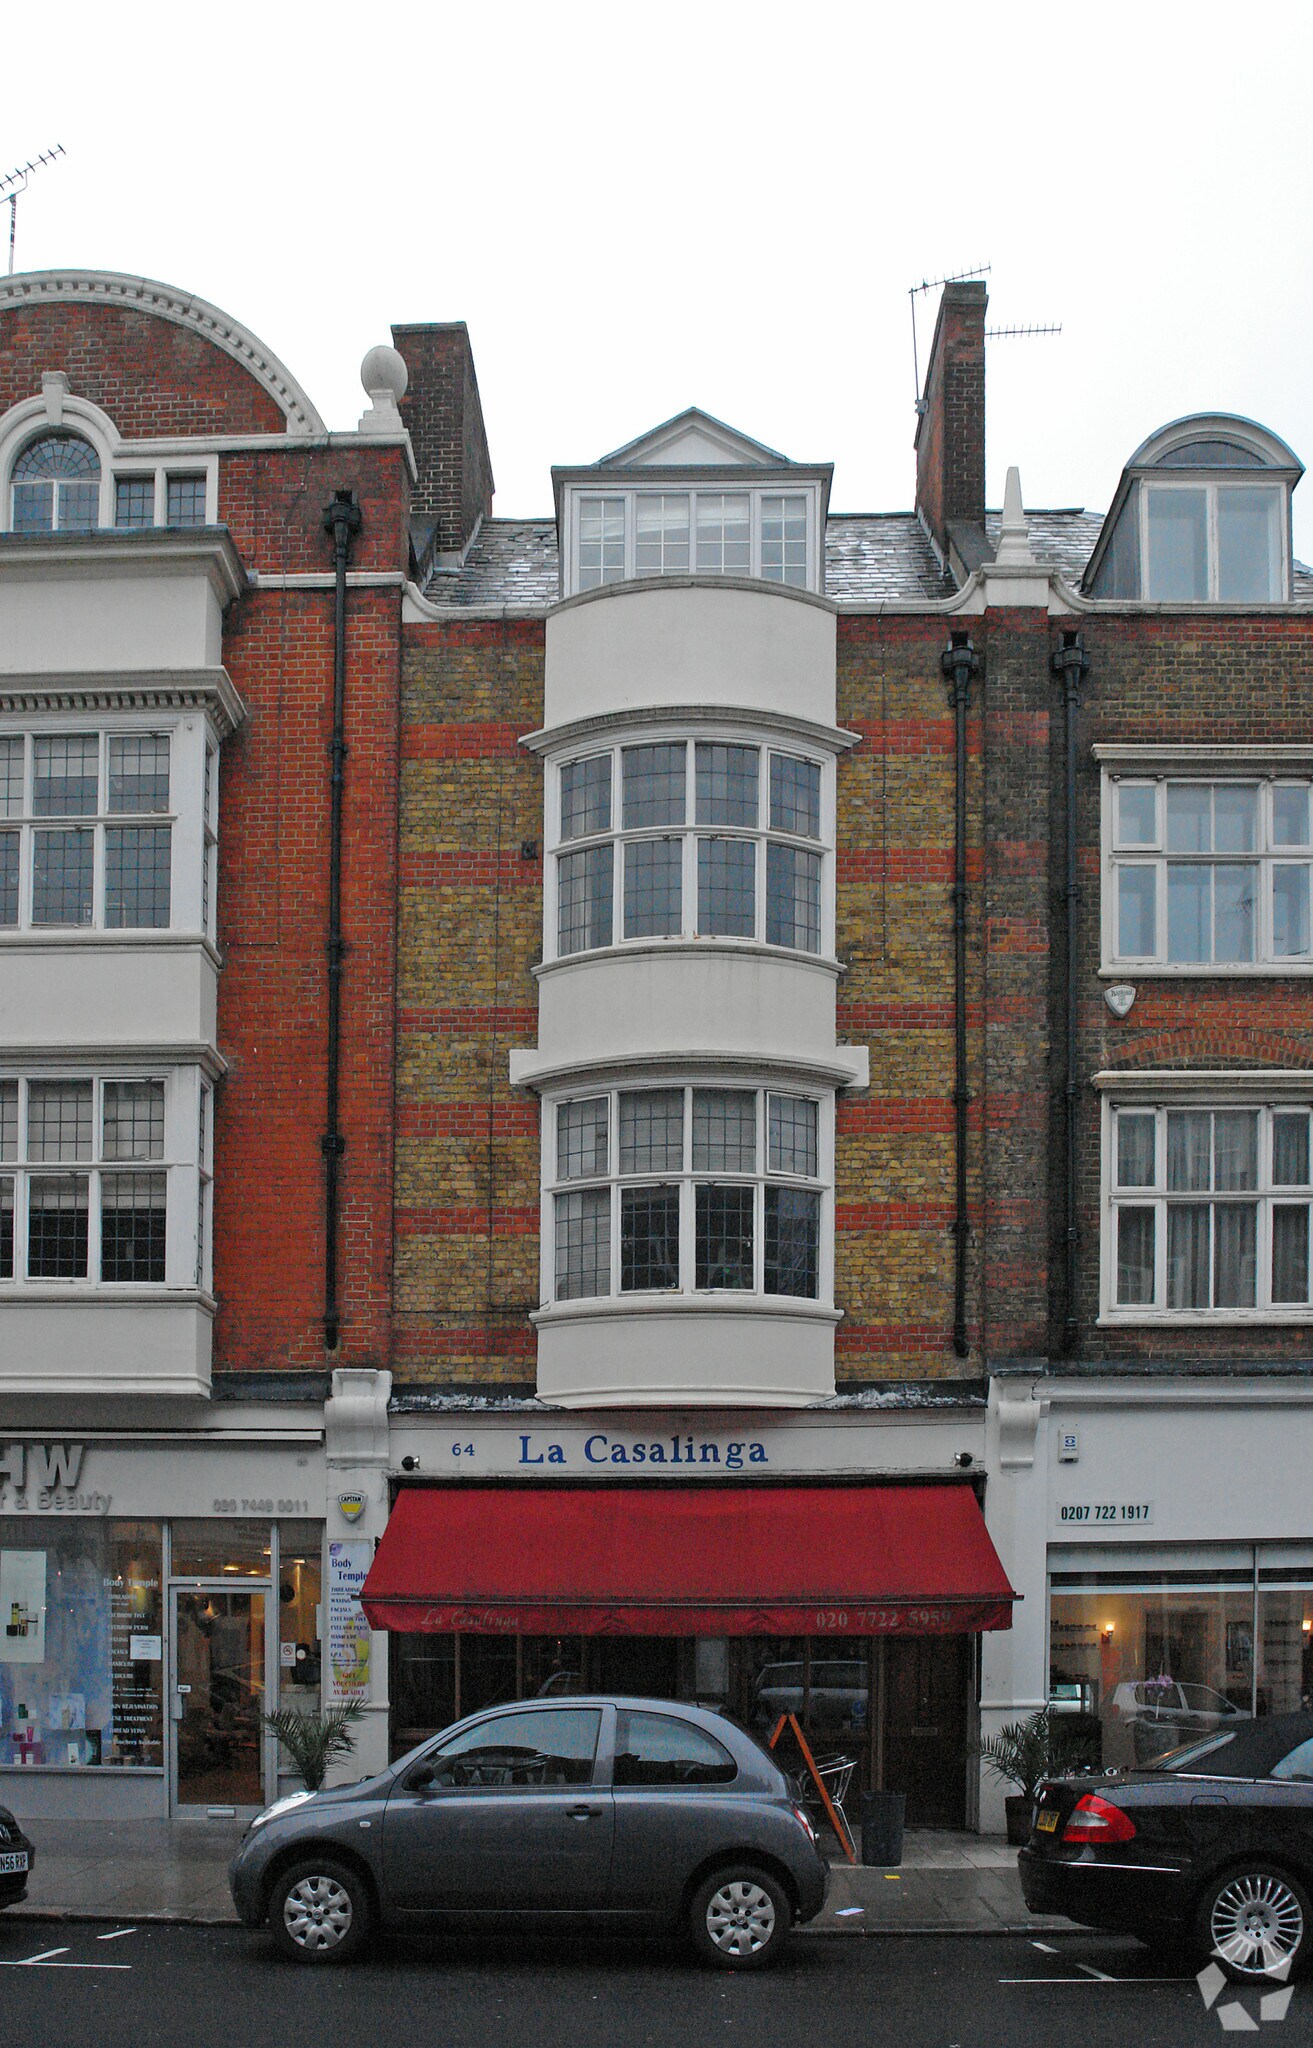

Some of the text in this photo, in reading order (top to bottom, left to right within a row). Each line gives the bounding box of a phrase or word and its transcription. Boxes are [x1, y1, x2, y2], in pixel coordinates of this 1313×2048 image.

[452, 1443, 475, 1456] 64
[519, 1435, 769, 1469] La Casalinga
[38, 1488, 113, 1515] Beauty
[213, 1498, 237, 1512] 020
[340, 1495, 362, 1503] CAPSTAN
[1061, 1505, 1149, 1520] 0207 722 1917
[331, 1558, 352, 1569] Body
[103, 1578, 124, 1588] Body
[338, 1571, 368, 1582] Temple
[420, 1607, 519, 1632] La Casalinga
[816, 1610, 952, 1628] 020 7722 5959
